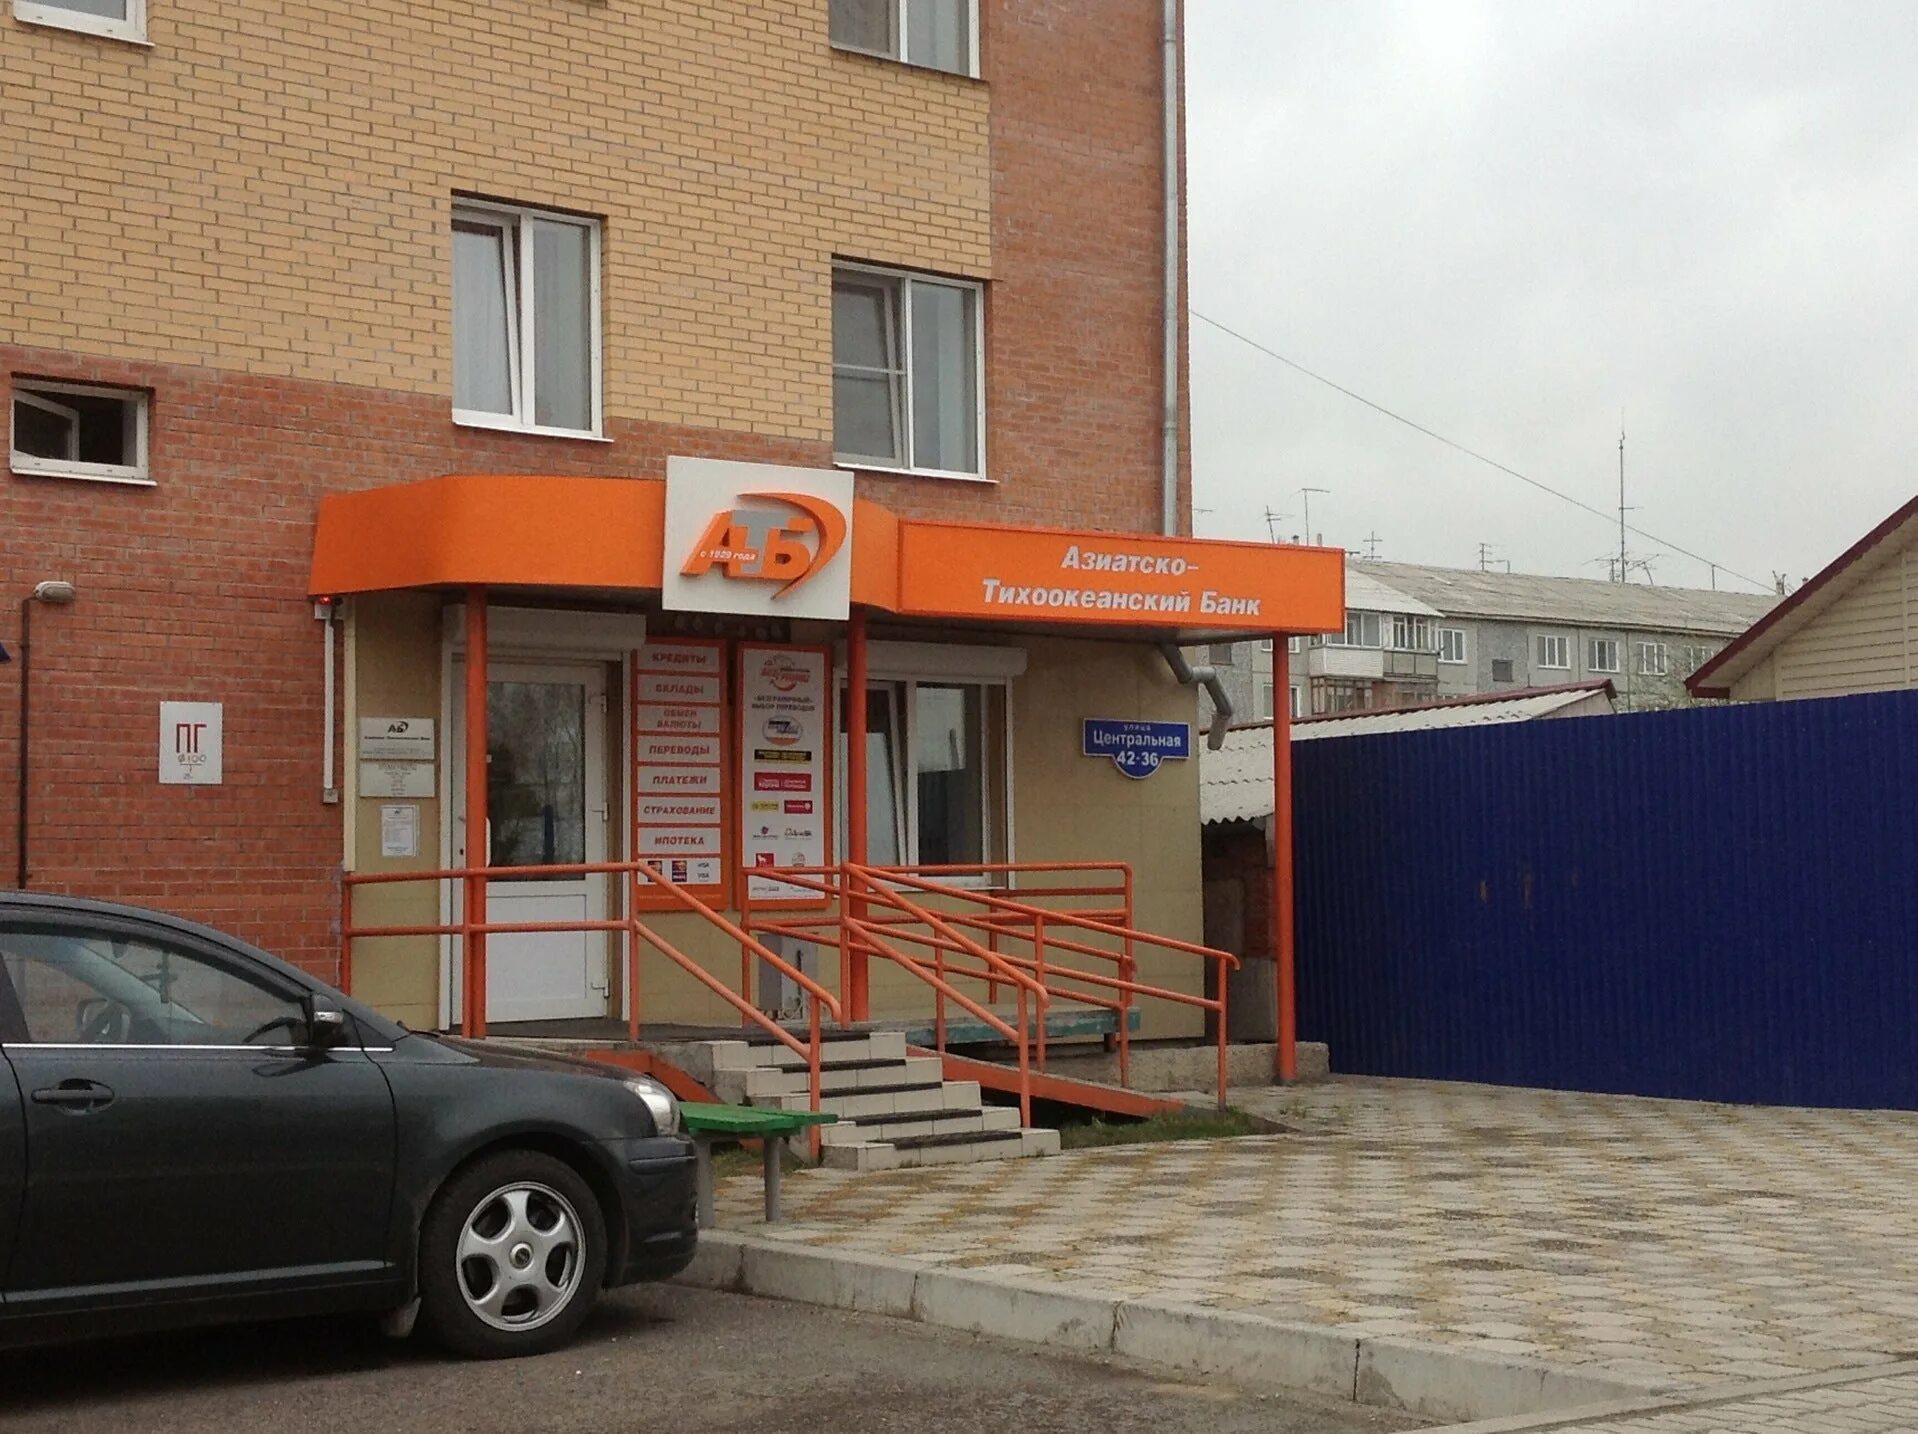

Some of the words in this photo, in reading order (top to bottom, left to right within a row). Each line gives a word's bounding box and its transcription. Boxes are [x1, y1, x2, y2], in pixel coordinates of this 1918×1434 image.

[679, 508, 818, 581] АТБ
[733, 552, 756, 561] года
[1060, 546, 1199, 576] Азиатско-
[982, 578, 1190, 613] Тихоокеанский
[1199, 591, 1261, 616] Банк
[652, 653, 706, 664] КРЕДИТЫ
[656, 684, 704, 695] ВКЛАДЫ
[657, 719, 702, 730] ВАЛЮТЫ
[176, 723, 207, 753] ПГ
[1093, 729, 1181, 748] Центральная
[649, 745, 710, 756] ПЕРЕВОДЫ
[652, 775, 707, 785] ПЛАТЕЖИ
[643, 805, 715, 816] СТРАХОВАНИЕ
[654, 836, 704, 846] ИПОТЕКА
